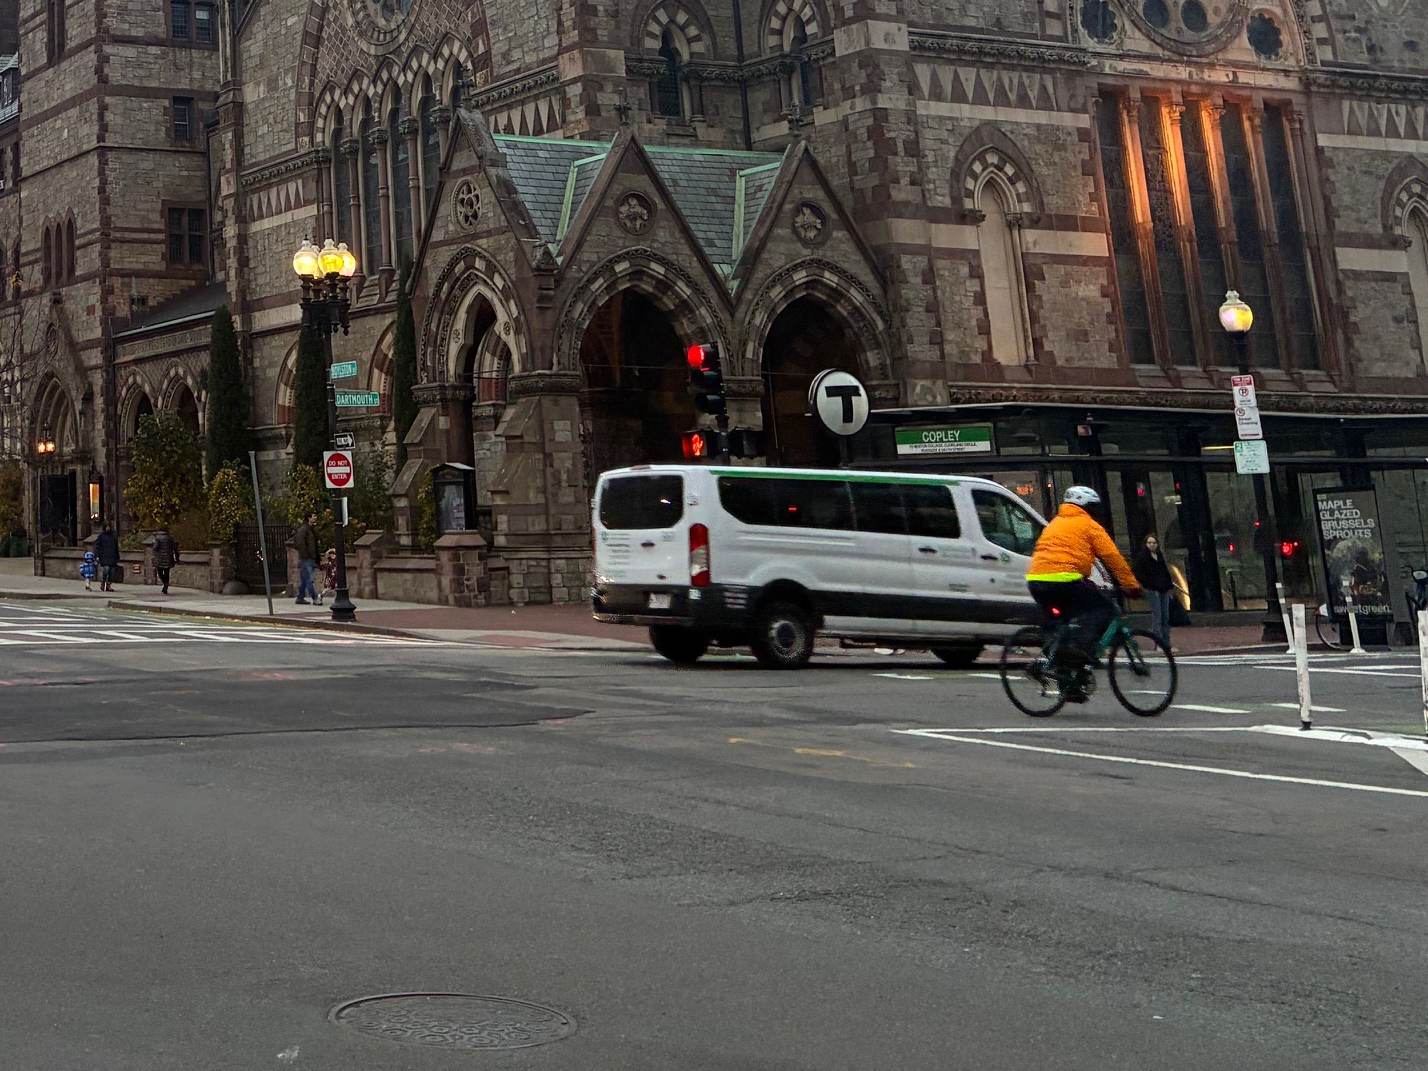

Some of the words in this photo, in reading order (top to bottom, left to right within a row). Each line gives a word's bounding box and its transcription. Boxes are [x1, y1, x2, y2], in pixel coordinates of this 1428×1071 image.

[336, 394, 373, 405] DARTMOUTH
[824, 384, 862, 424] T
[922, 430, 960, 442] COPLEY
[1318, 500, 1353, 510] MAPLE
[1320, 509, 1360, 520] GLAZED
[1321, 518, 1375, 530] BRUSSELS
[1323, 529, 1372, 540] SPROUTS
[1333, 603, 1390, 615] swetgreen
